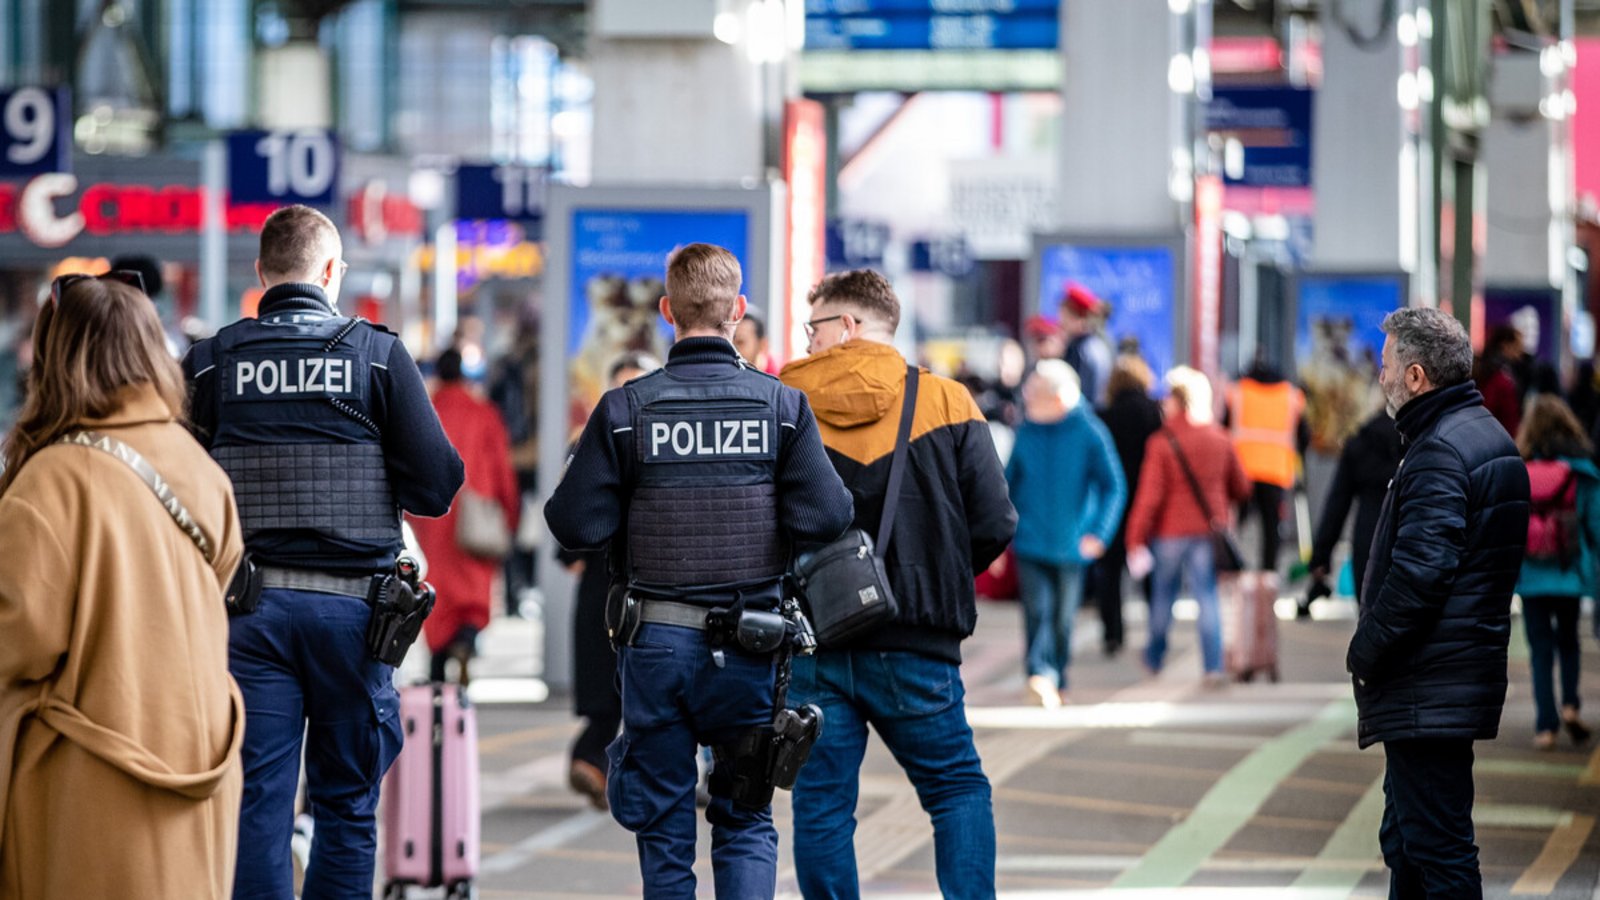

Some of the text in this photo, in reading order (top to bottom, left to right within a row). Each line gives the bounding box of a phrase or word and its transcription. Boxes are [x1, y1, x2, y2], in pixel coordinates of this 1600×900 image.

[4, 87, 54, 164] 9
[256, 134, 335, 197] 10
[236, 357, 352, 396] POLIZEI
[651, 419, 769, 456] POLIZEI
